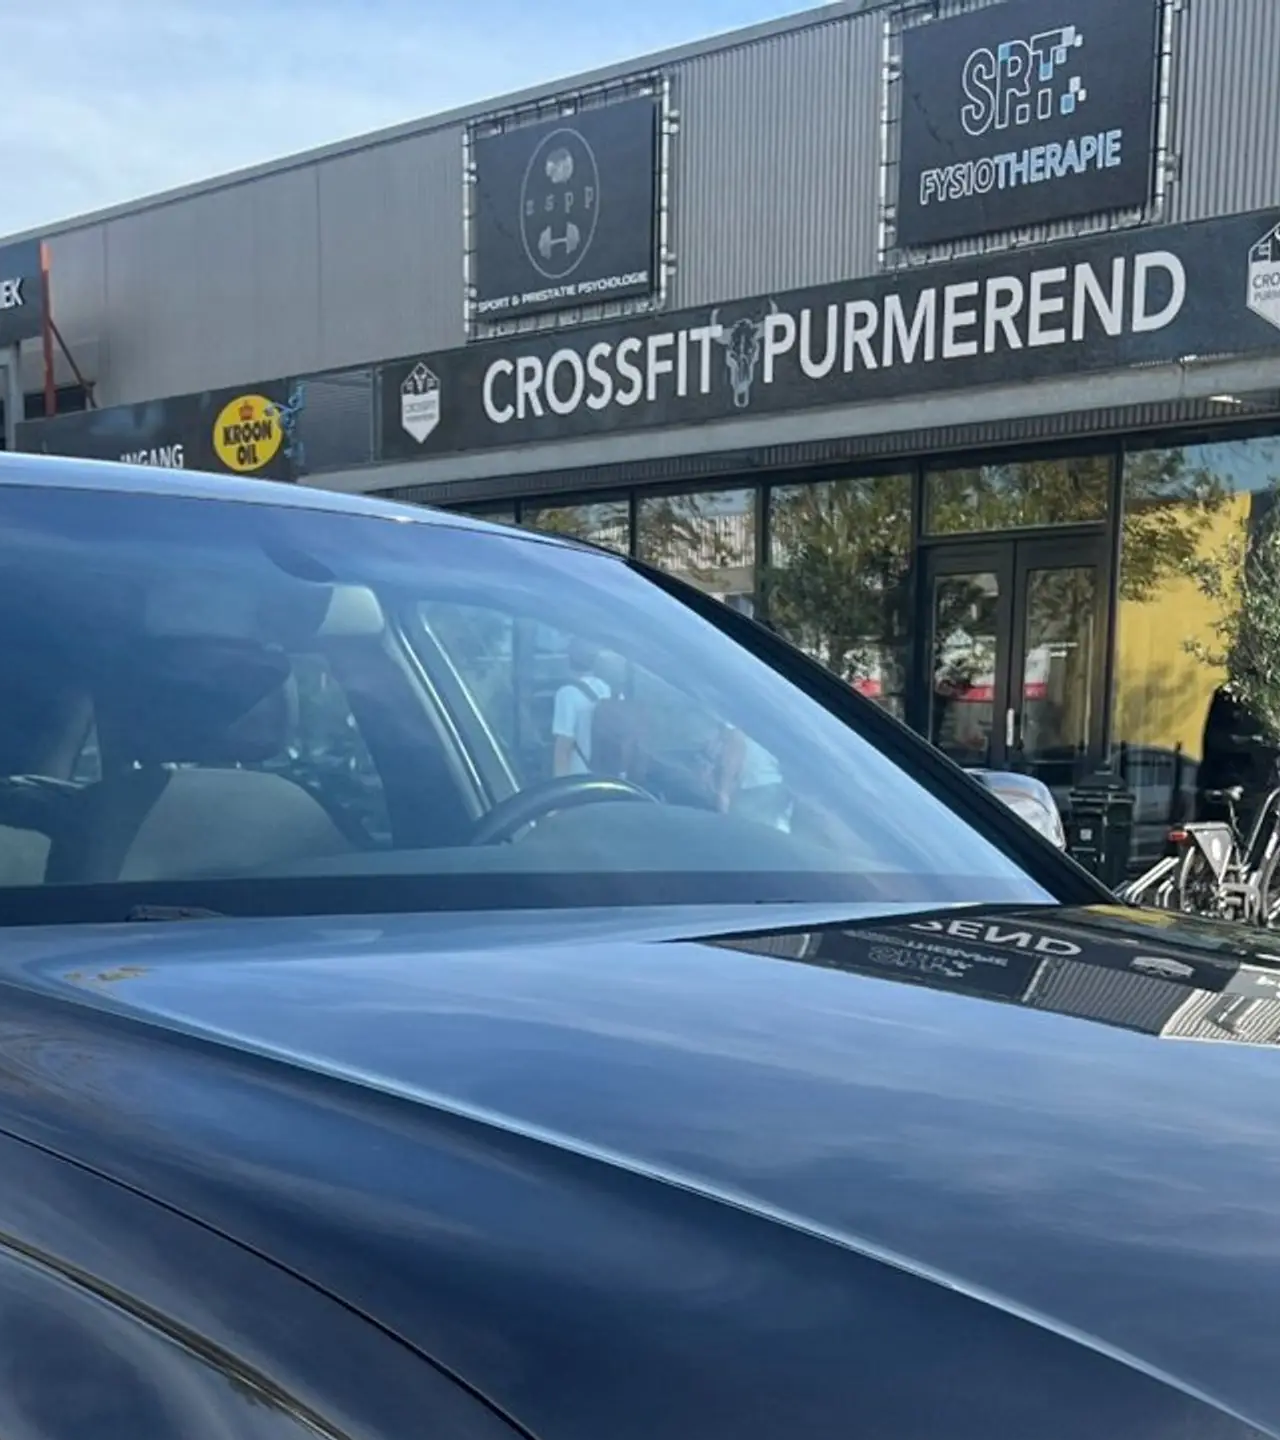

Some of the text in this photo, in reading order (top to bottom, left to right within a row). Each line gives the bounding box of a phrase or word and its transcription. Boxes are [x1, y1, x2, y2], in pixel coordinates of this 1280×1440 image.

[961, 25, 1083, 135] SRT
[920, 129, 1123, 206] FYSIOTHERAPIE
[482, 250, 1187, 424] CROSSFIT PURMEREND
[223, 421, 273, 446] KROON
[236, 445, 259, 466] OIL
